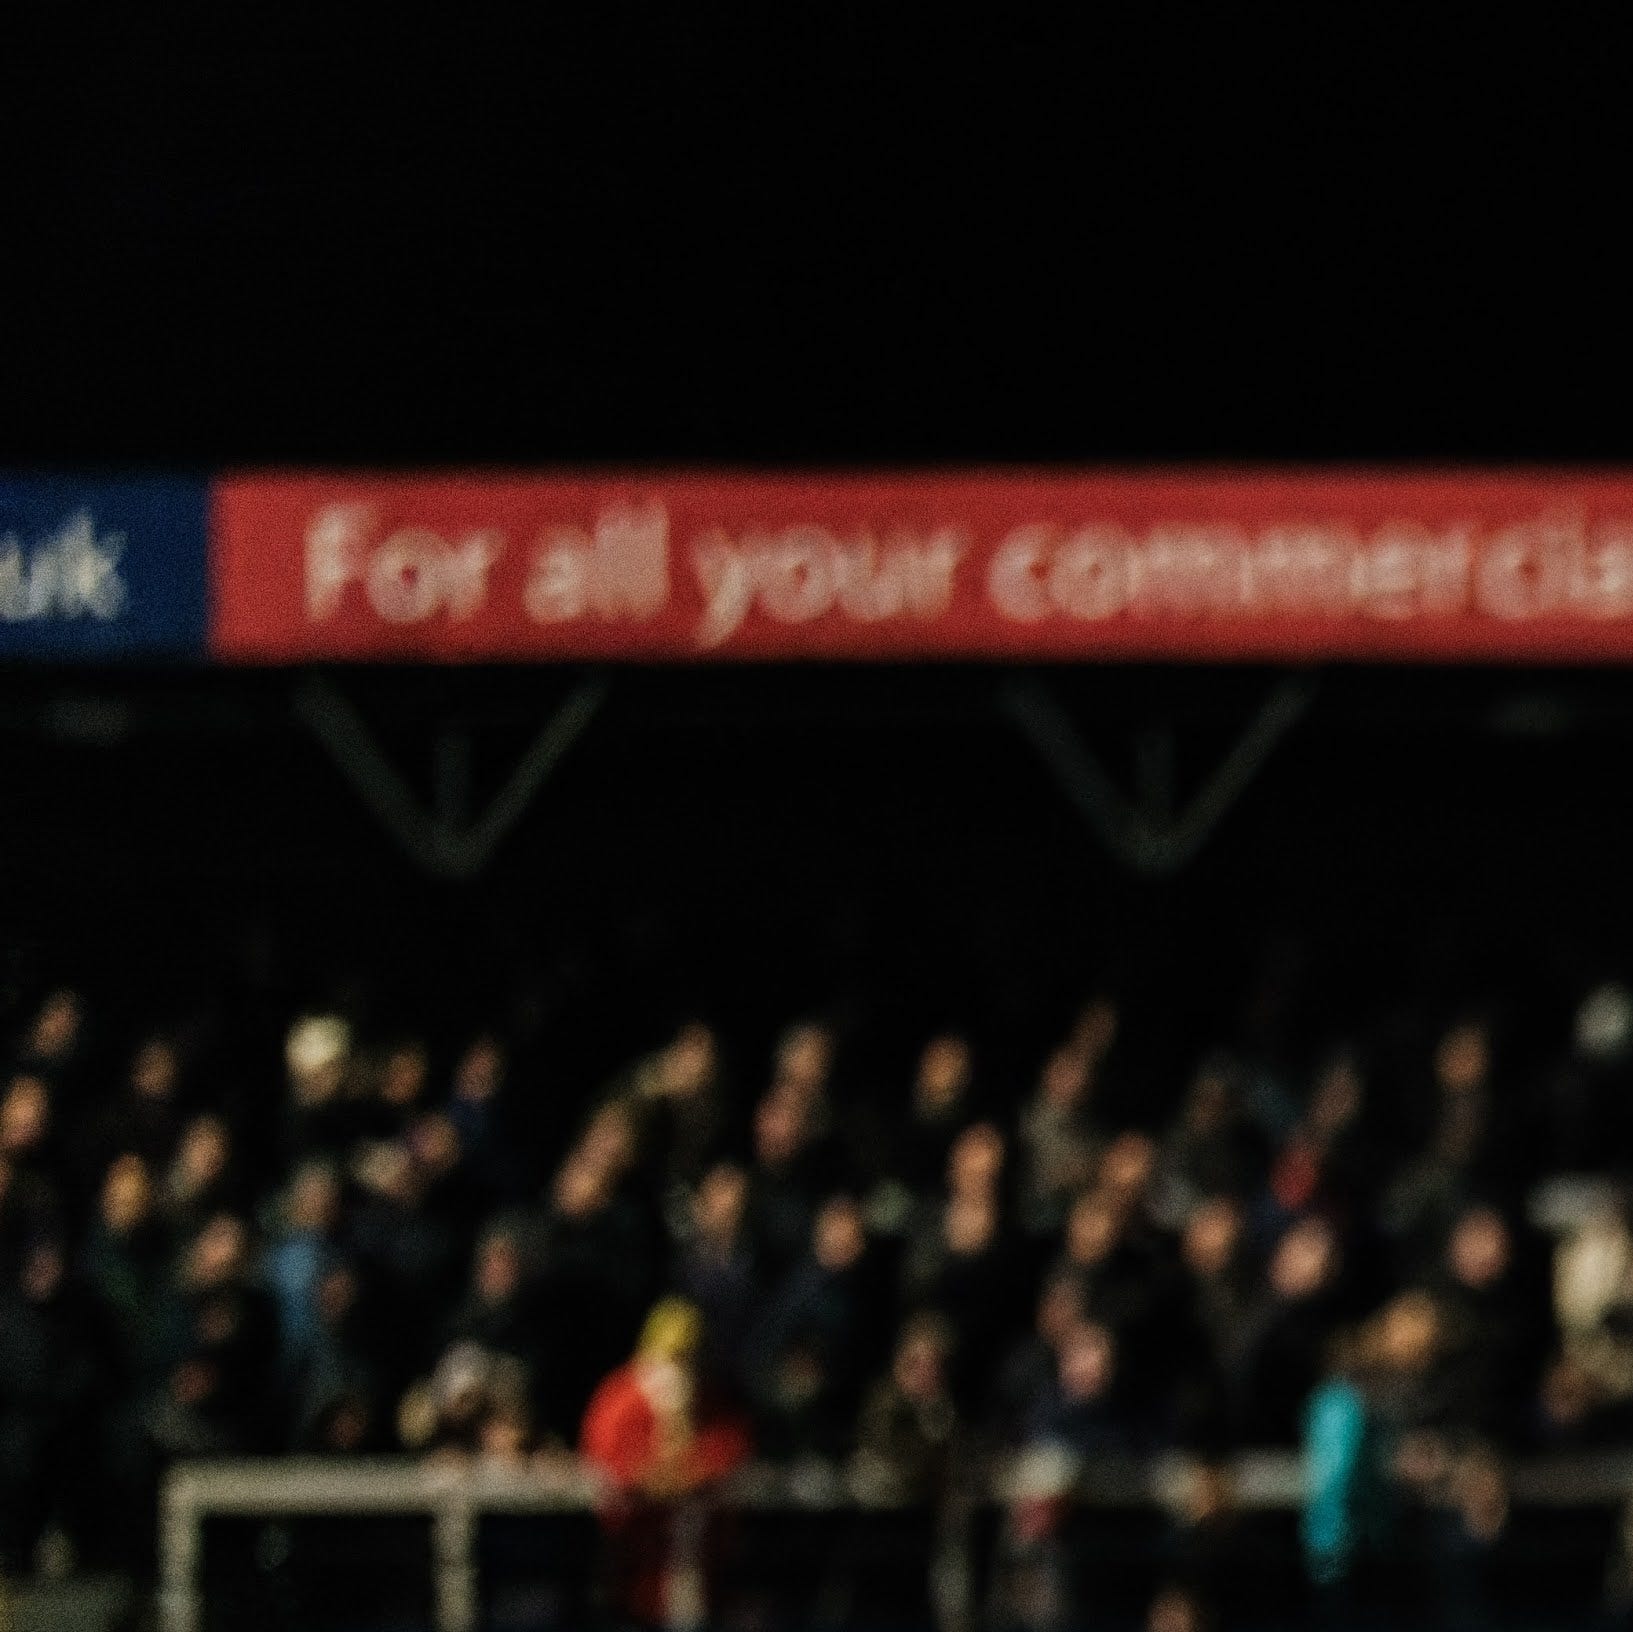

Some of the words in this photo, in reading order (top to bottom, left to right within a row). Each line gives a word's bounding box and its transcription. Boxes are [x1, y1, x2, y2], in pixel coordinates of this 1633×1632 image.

[305, 502, 502, 624] For
[522, 500, 670, 623] all
[692, 524, 970, 650] your
